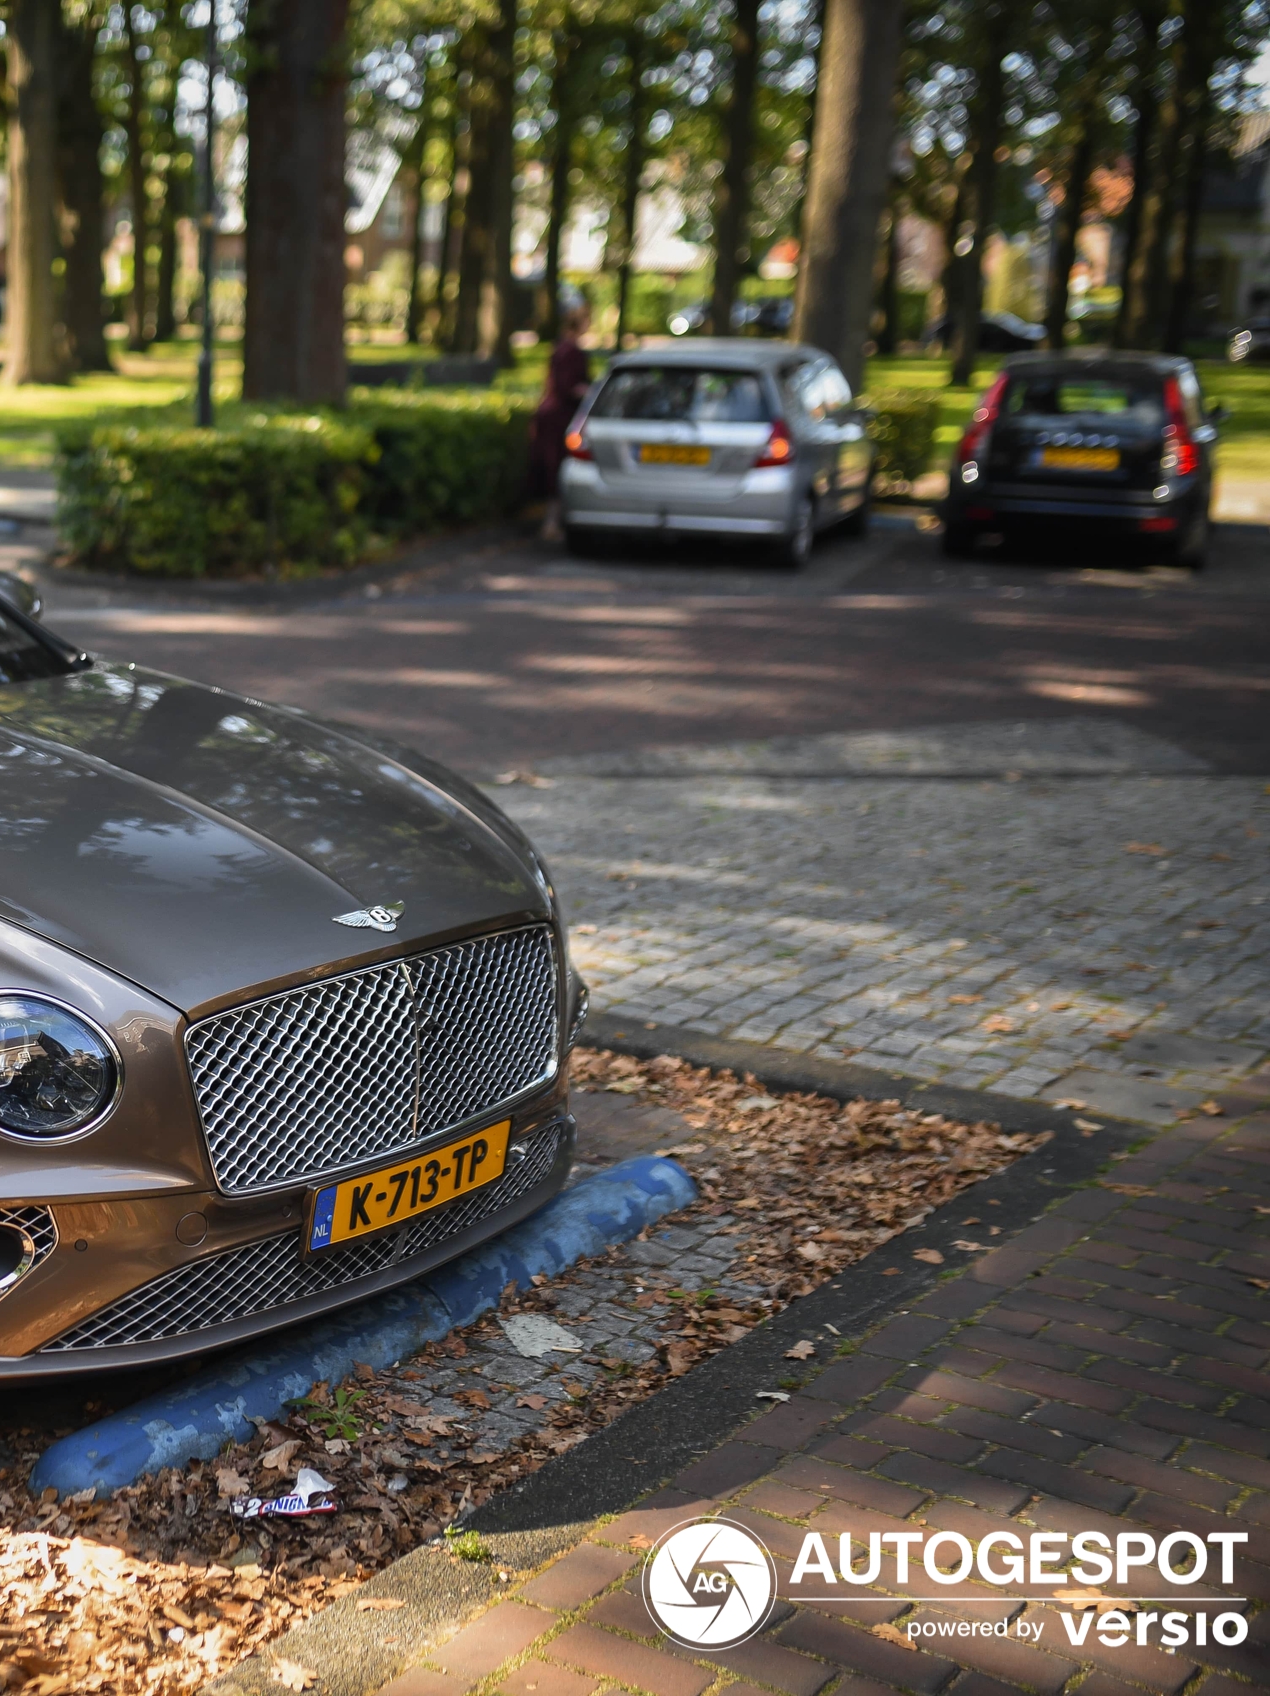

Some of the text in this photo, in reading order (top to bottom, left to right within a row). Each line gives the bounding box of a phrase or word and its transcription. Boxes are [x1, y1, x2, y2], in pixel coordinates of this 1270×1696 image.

[369, 908, 391, 923] B
[349, 1138, 488, 1231] K-713-TP
[313, 1223, 328, 1239] NL
